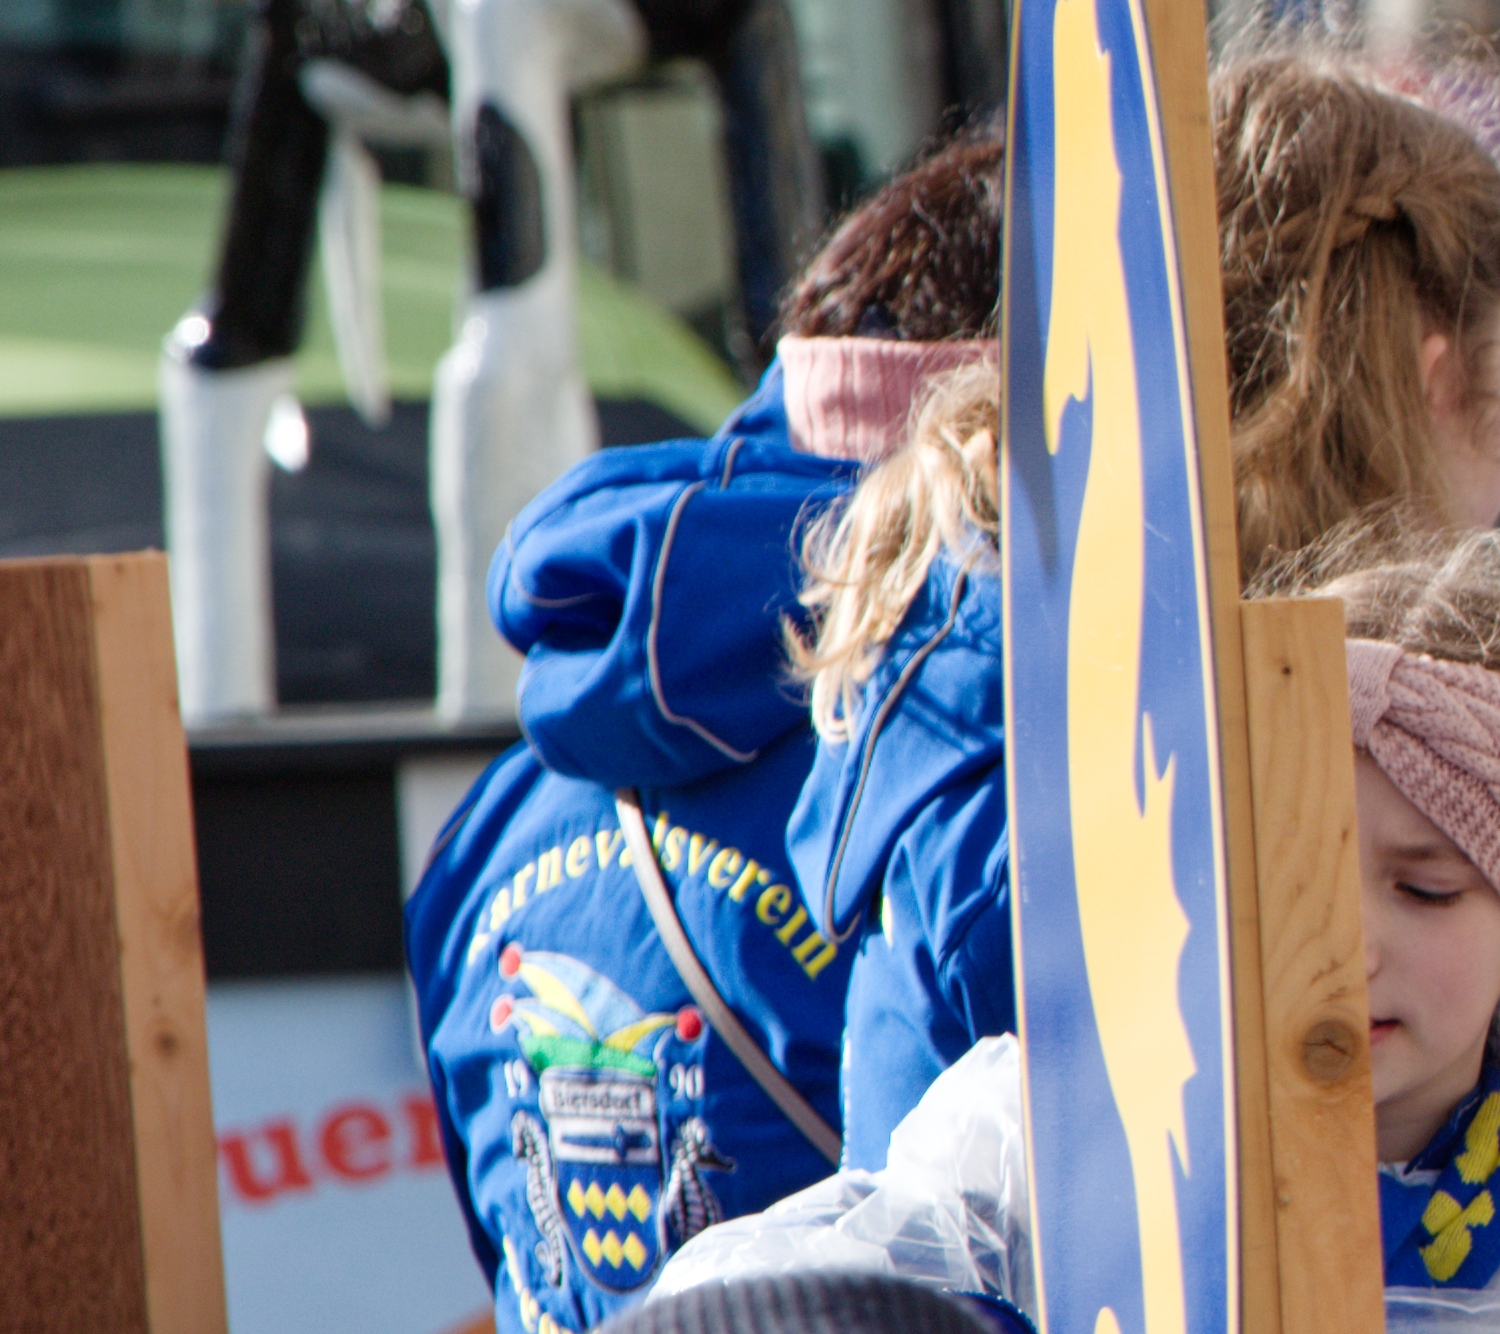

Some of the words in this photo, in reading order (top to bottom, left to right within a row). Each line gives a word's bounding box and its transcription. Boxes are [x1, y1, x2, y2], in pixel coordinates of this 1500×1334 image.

[504, 1059, 530, 1098] 19
[668, 1062, 705, 1099] 90
[553, 1089, 642, 1109] Biersdorf
